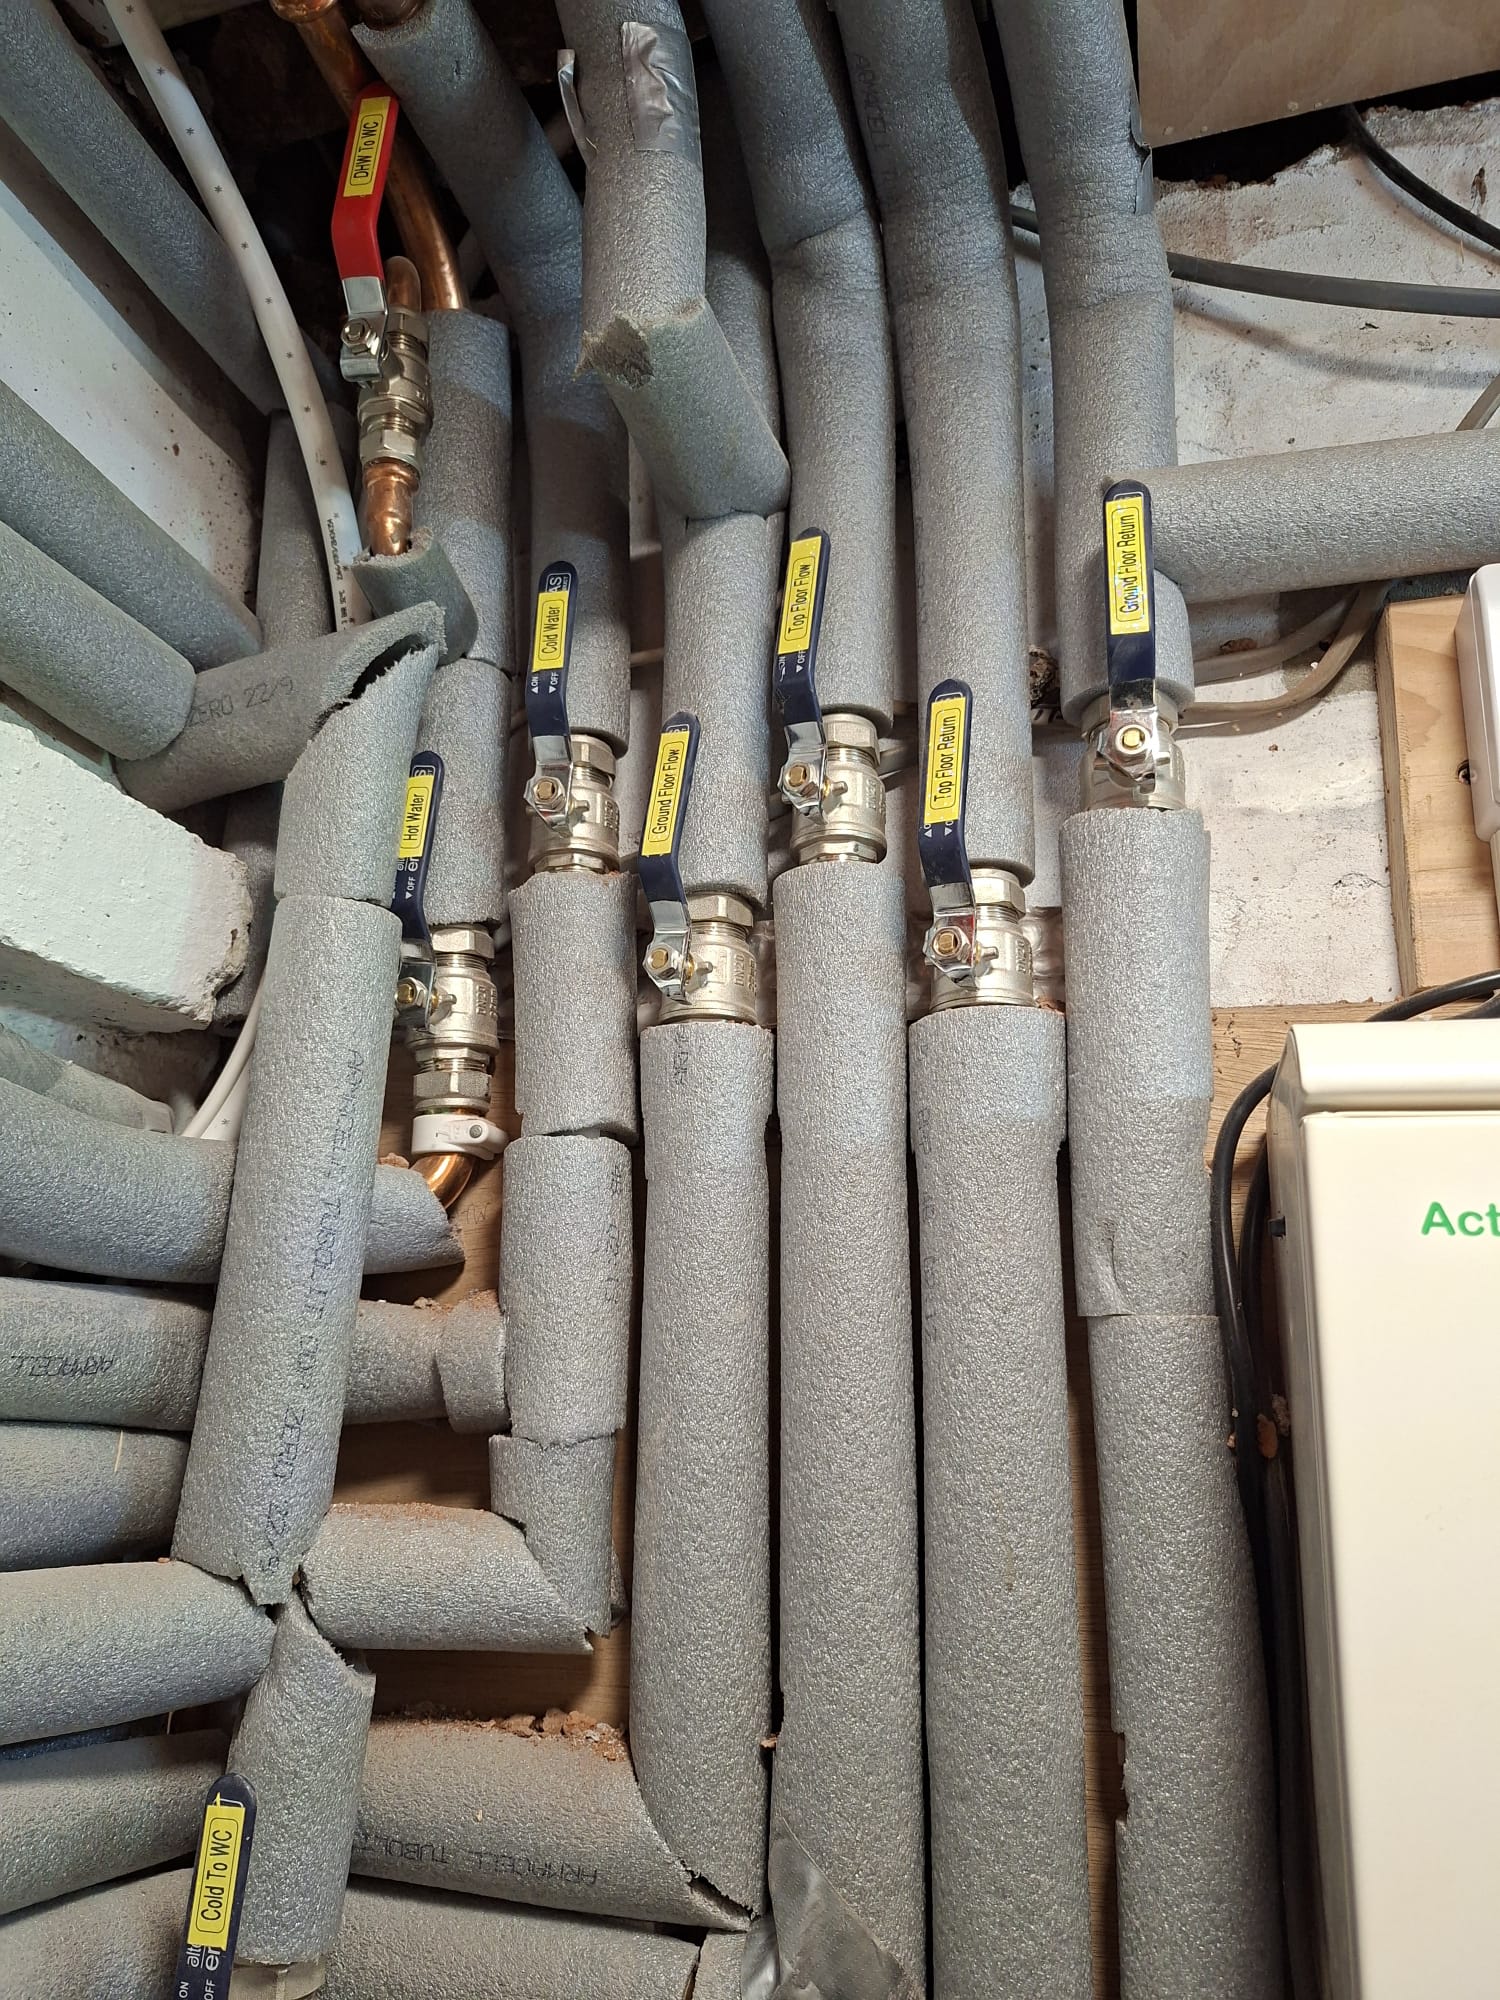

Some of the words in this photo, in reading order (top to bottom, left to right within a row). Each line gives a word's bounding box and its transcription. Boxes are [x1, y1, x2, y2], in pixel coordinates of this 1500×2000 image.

[361, 121, 379, 139] WC
[358, 140, 375, 153] To
[353, 155, 372, 179] DHW
[1117, 514, 1136, 548] Return
[1118, 550, 1137, 576] Floor
[793, 564, 811, 588] Flow
[790, 588, 808, 613] Floor
[1119, 576, 1140, 614] Ground
[543, 606, 560, 633] Water
[788, 613, 809, 635] Top
[541, 634, 558, 654] Cold
[550, 672, 559, 685] OFF
[937, 715, 956, 751] Return
[662, 749, 680, 772] Flow
[935, 754, 953, 779] Floor
[658, 773, 676, 798] Floor
[933, 781, 955, 802] Top
[406, 793, 425, 823] Water
[652, 799, 672, 835] Ground
[403, 825, 420, 841] Hot
[406, 876, 416, 891] OFF
[1421, 1201, 1500, 1237] Act
[210, 1829, 233, 1858] WC
[206, 1862, 228, 1884] To
[200, 1886, 225, 1922] Cold
[179, 1981, 190, 1999] ON
[204, 1978, 216, 2000] OFF
